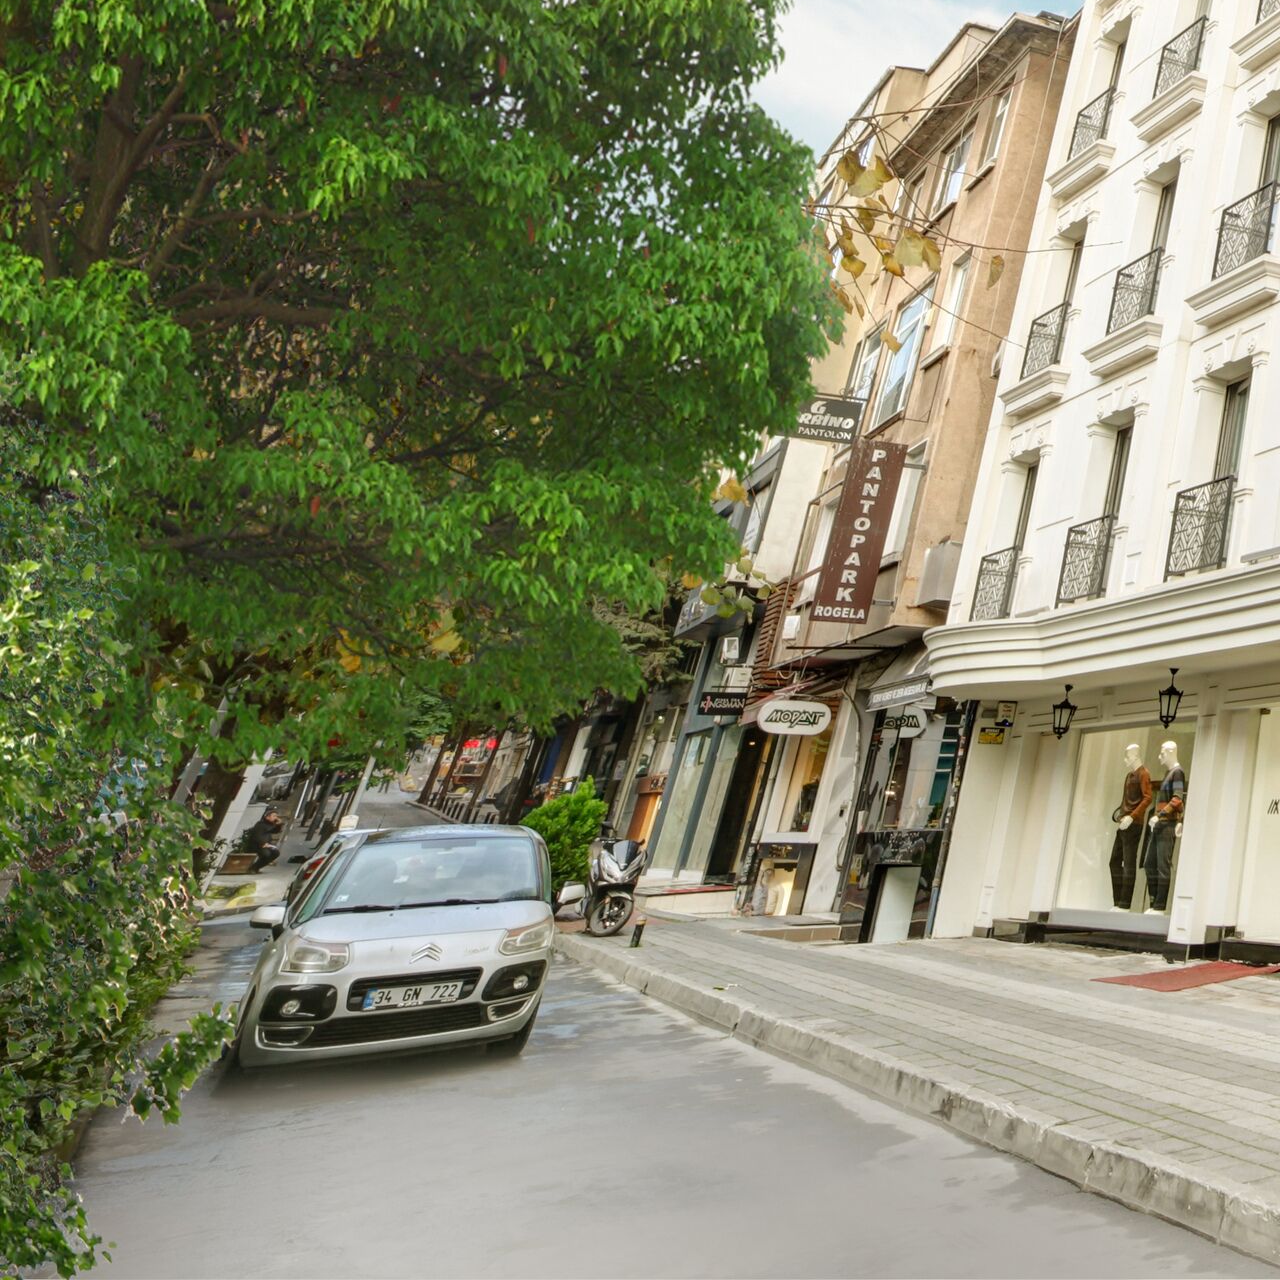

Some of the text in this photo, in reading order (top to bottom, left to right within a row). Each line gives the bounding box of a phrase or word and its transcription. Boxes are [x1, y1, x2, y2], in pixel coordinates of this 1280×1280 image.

[798, 426, 852, 440] PANTOLON
[835, 449, 887, 602] PANTOPARK
[814, 605, 865, 619] ROGELA
[766, 709, 826, 728] MOPANT
[374, 984, 458, 1004] 34 GN 722
